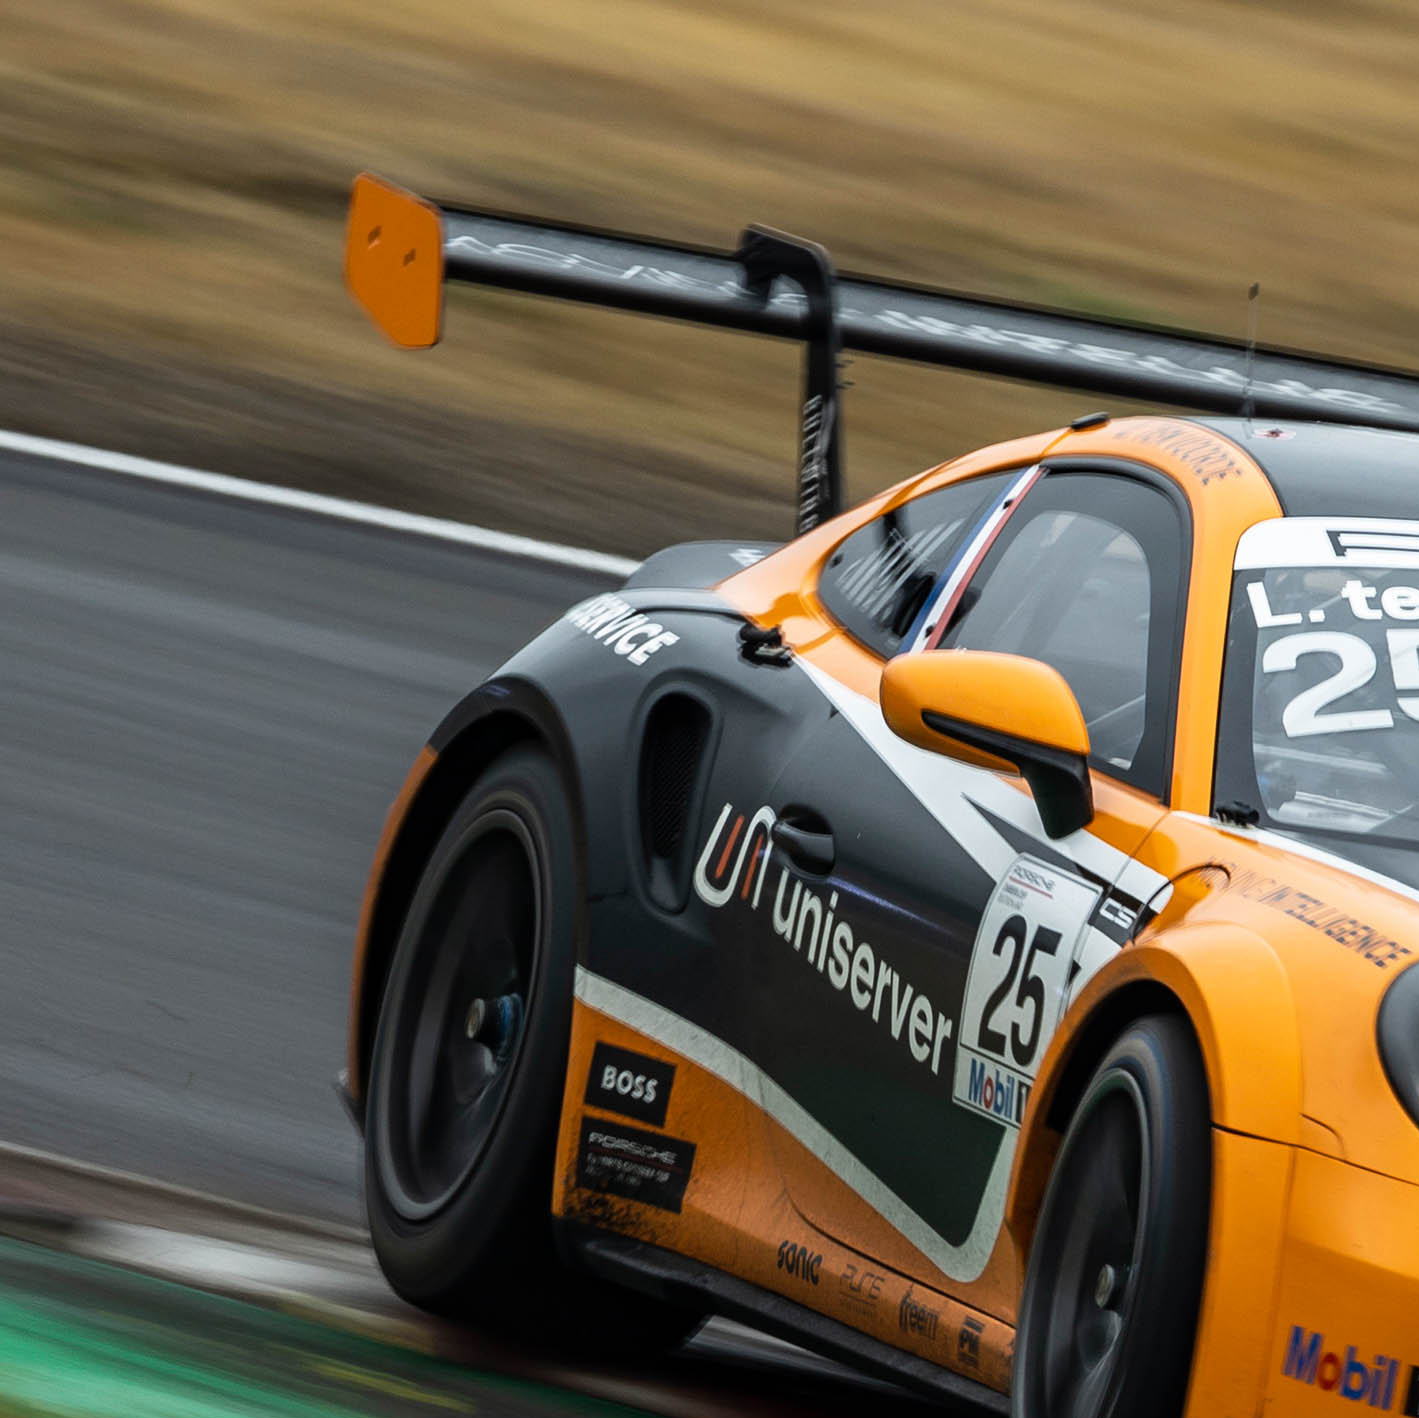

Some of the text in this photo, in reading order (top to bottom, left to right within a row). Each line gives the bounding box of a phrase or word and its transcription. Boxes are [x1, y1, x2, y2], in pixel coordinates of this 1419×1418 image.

[1247, 580, 1325, 629] L.
[772, 867, 953, 1075] uniserver
[976, 914, 1062, 1067] 25
[600, 1064, 659, 1104] BOSS
[968, 1057, 1015, 1121] Mobil
[1282, 1325, 1400, 1411] Mobil
